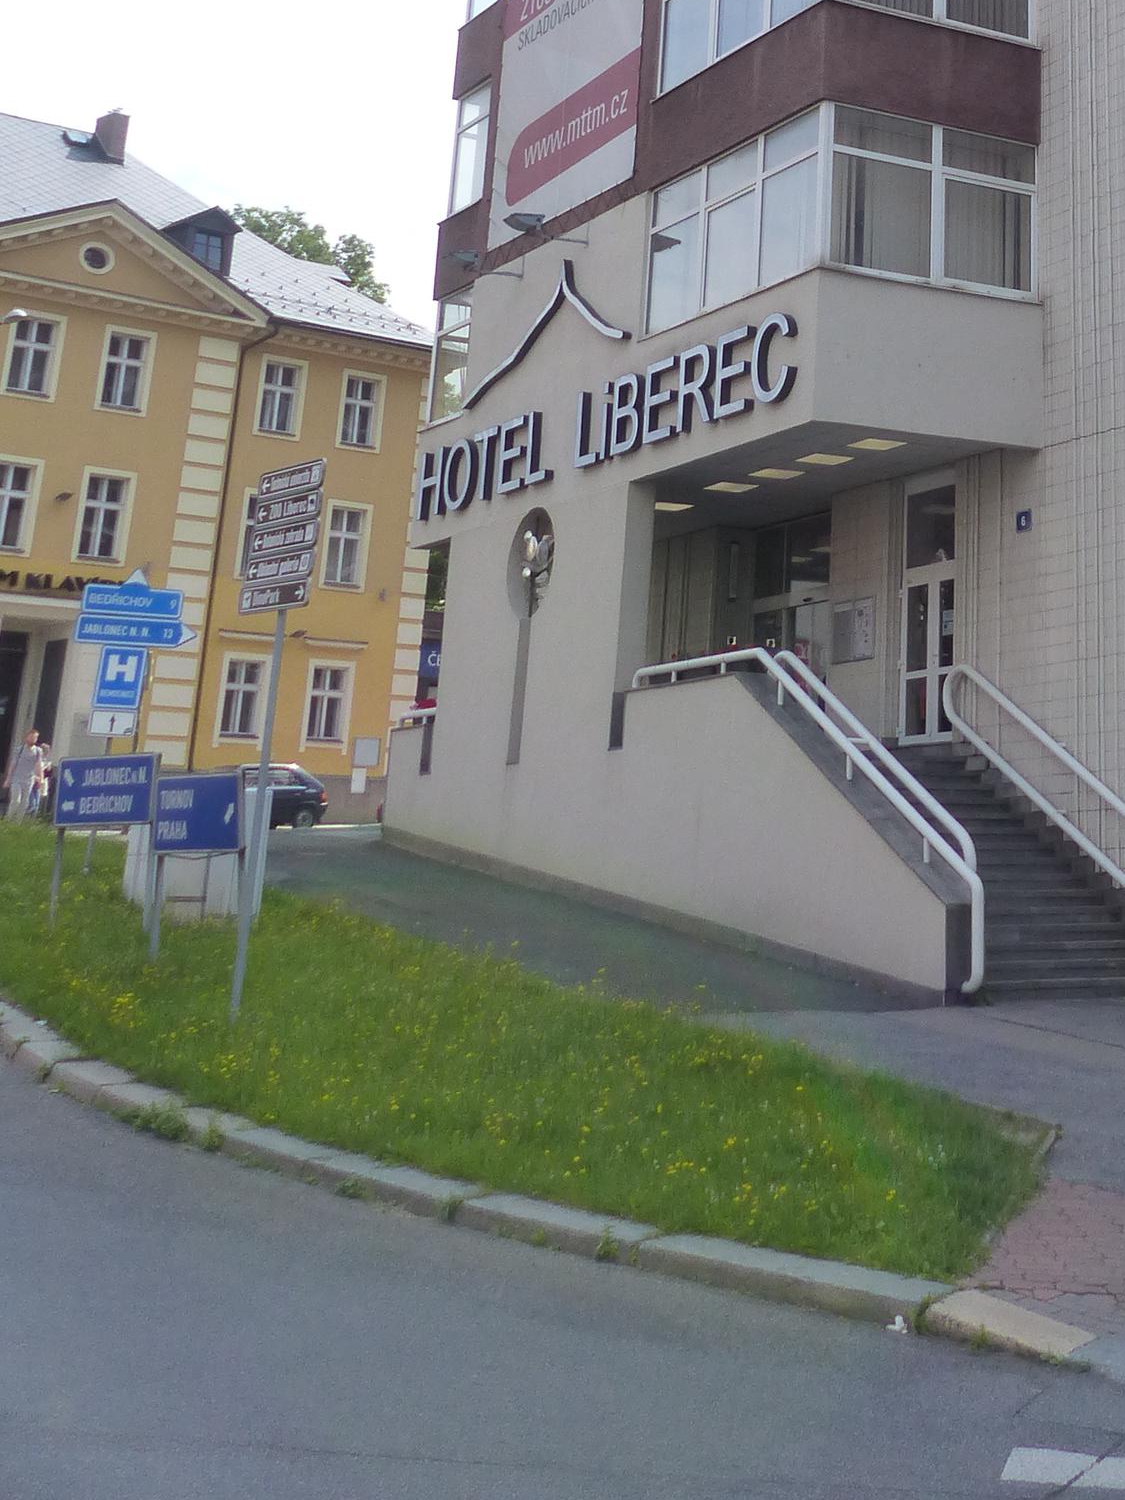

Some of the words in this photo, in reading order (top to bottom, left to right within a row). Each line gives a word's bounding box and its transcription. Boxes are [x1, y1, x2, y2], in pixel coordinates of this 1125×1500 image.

[524, 89, 629, 169] www.mttm.cz
[416, 411, 554, 521] HOTEL
[88, 592, 153, 608] BEDŘICHOV
[81, 623, 128, 636] JABLONEC
[163, 628, 174, 639] 13
[82, 766, 131, 787] JABLONEC
[79, 792, 134, 814] BEDŘICHOV
[160, 789, 194, 810] TURNOV
[157, 820, 188, 841] PRAHA
